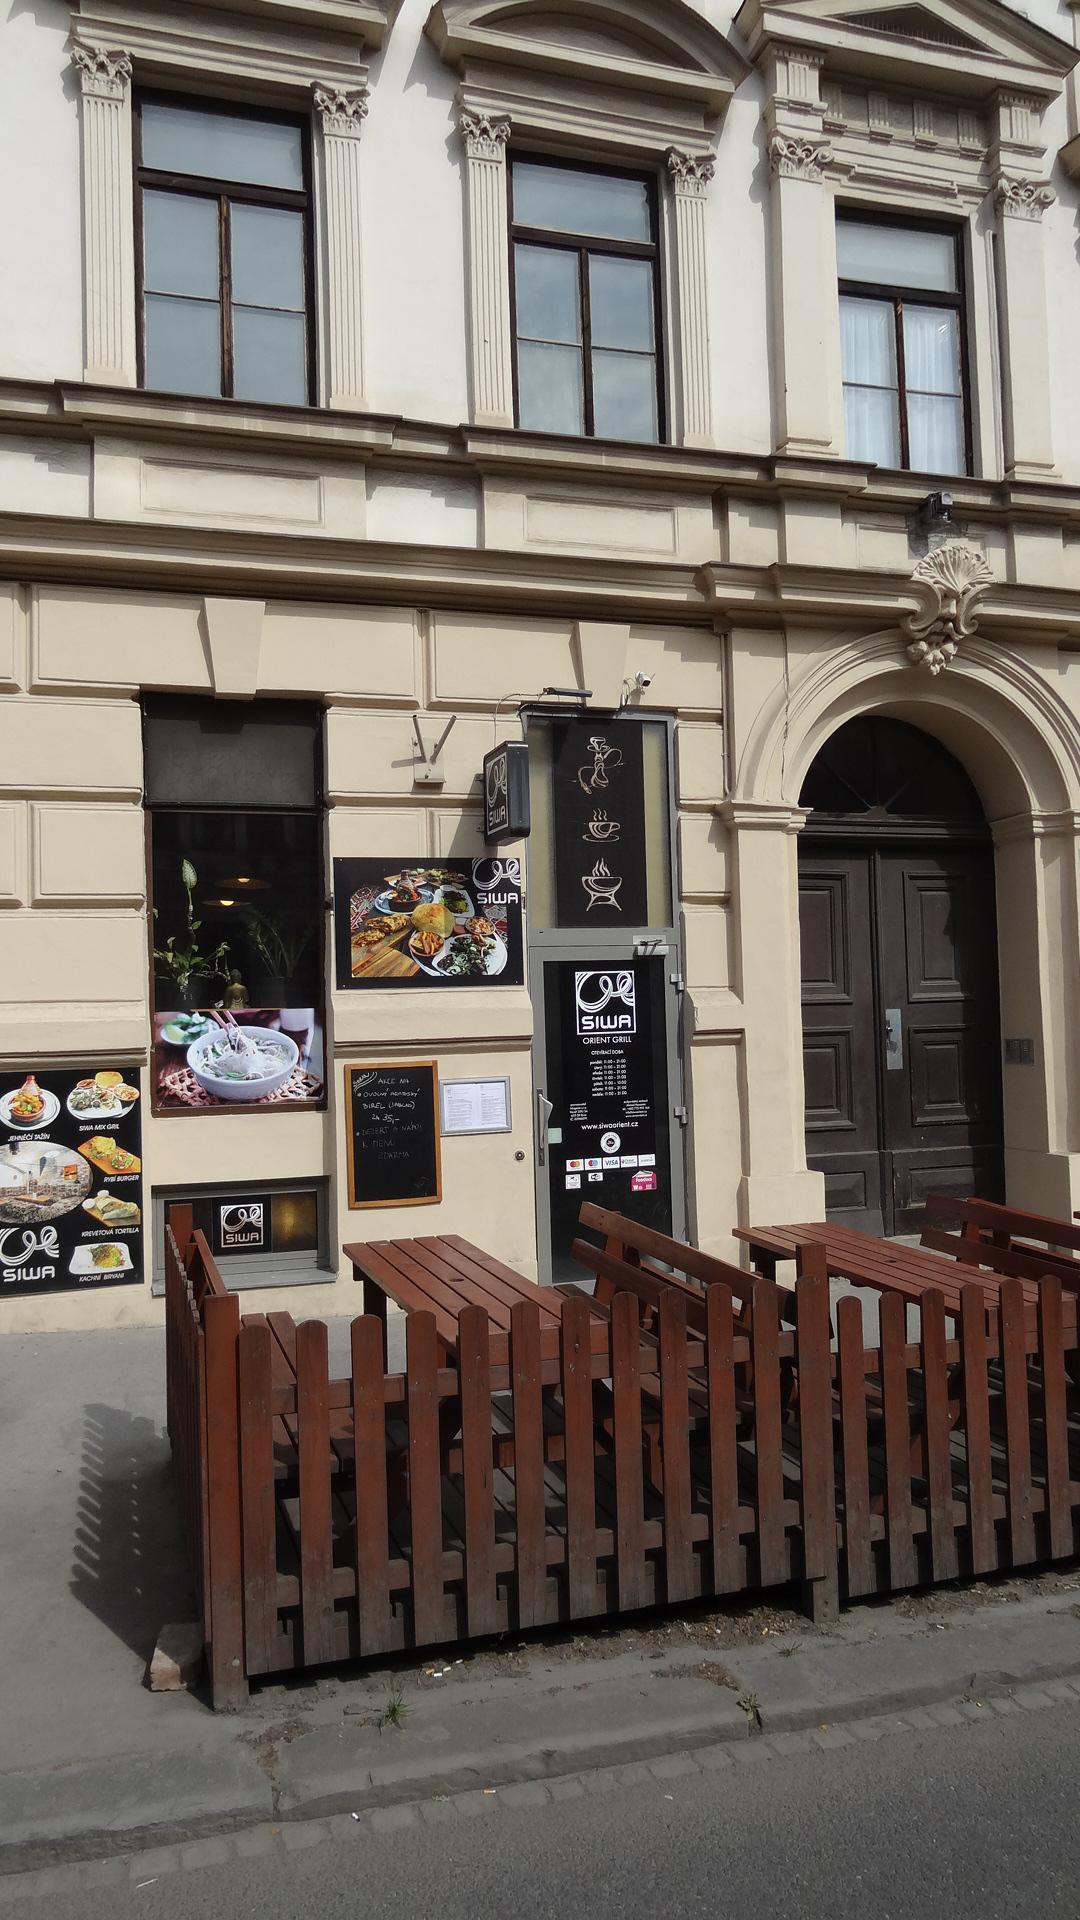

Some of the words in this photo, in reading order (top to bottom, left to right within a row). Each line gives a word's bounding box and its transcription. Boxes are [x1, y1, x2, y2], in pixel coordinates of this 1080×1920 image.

[489, 806, 506, 826] SIWA
[477, 892, 519, 904] SIWA
[581, 1015, 631, 1030] SIWA
[582, 1036, 611, 1044] ORIENT
[581, 1121, 639, 1130] www.siwaorient.cz
[103, 1175, 117, 1183] RYBÍ
[117, 1174, 140, 1182] BURGER
[81, 1228, 114, 1237] KREVETOVÁ
[225, 1232, 259, 1243] SIWA
[2, 1265, 56, 1282] SIWA
[79, 1273, 102, 1282] KACHNÍ
